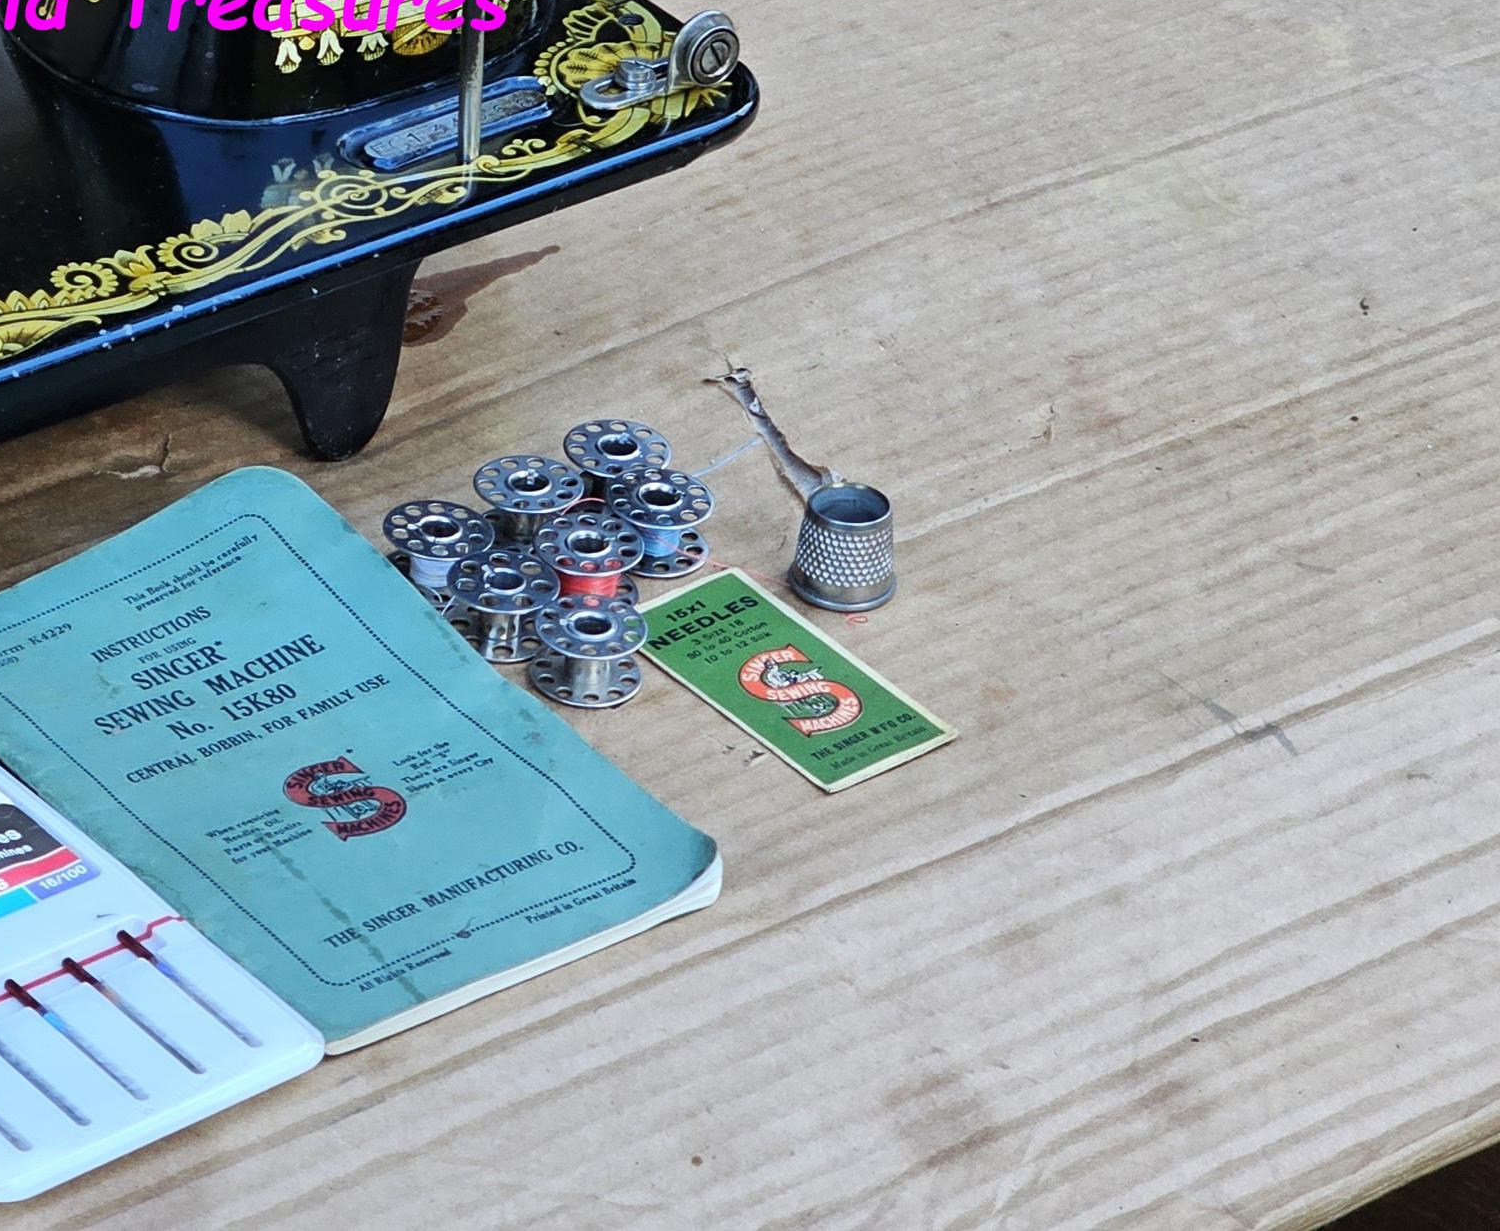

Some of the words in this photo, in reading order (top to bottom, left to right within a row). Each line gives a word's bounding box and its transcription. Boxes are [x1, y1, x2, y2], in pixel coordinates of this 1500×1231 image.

[124, 593, 146, 605] This
[146, 580, 171, 596] Book
[173, 565, 202, 583] should
[201, 559, 215, 569] be
[217, 534, 258, 561] carefully
[135, 586, 180, 612] preserved
[181, 580, 196, 590] for
[28, 622, 73, 646] K4229
[90, 605, 211, 664] INSTRUCTIONS
[647, 596, 759, 650] NEEDLES
[733, 621, 768, 638] Cotton
[138, 648, 162, 665] FOR
[162, 637, 197, 654] USING
[704, 654, 718, 664] 10
[720, 648, 733, 656] to
[94, 689, 197, 736] SEWING
[202, 634, 326, 697] MACHINE
[766, 681, 831, 701] SEWING
[165, 719, 214, 741] No.
[219, 683, 298, 722] 15K80
[800, 696, 860, 733] MACHINES
[125, 752, 198, 784] CENTRAL
[197, 729, 263, 759] BOBBIN,
[264, 716, 297, 735] FOR
[297, 688, 355, 720] FAMILY
[356, 674, 391, 695] USE
[810, 746, 835, 760] THE
[833, 731, 870, 751] SINGER
[307, 786, 376, 806] SEWING
[336, 800, 402, 835] MACHINES
[39, 863, 88, 891] 16/100
[323, 923, 361, 948] THE
[362, 902, 422, 933] SINGER
[422, 849, 553, 908] MANUFACTURING
[554, 840, 585, 857] CO.
[525, 903, 562, 925] Printed
[562, 900, 573, 911] in
[573, 888, 602, 907] Great
[602, 876, 638, 897] Britain
[358, 979, 375, 993] All
